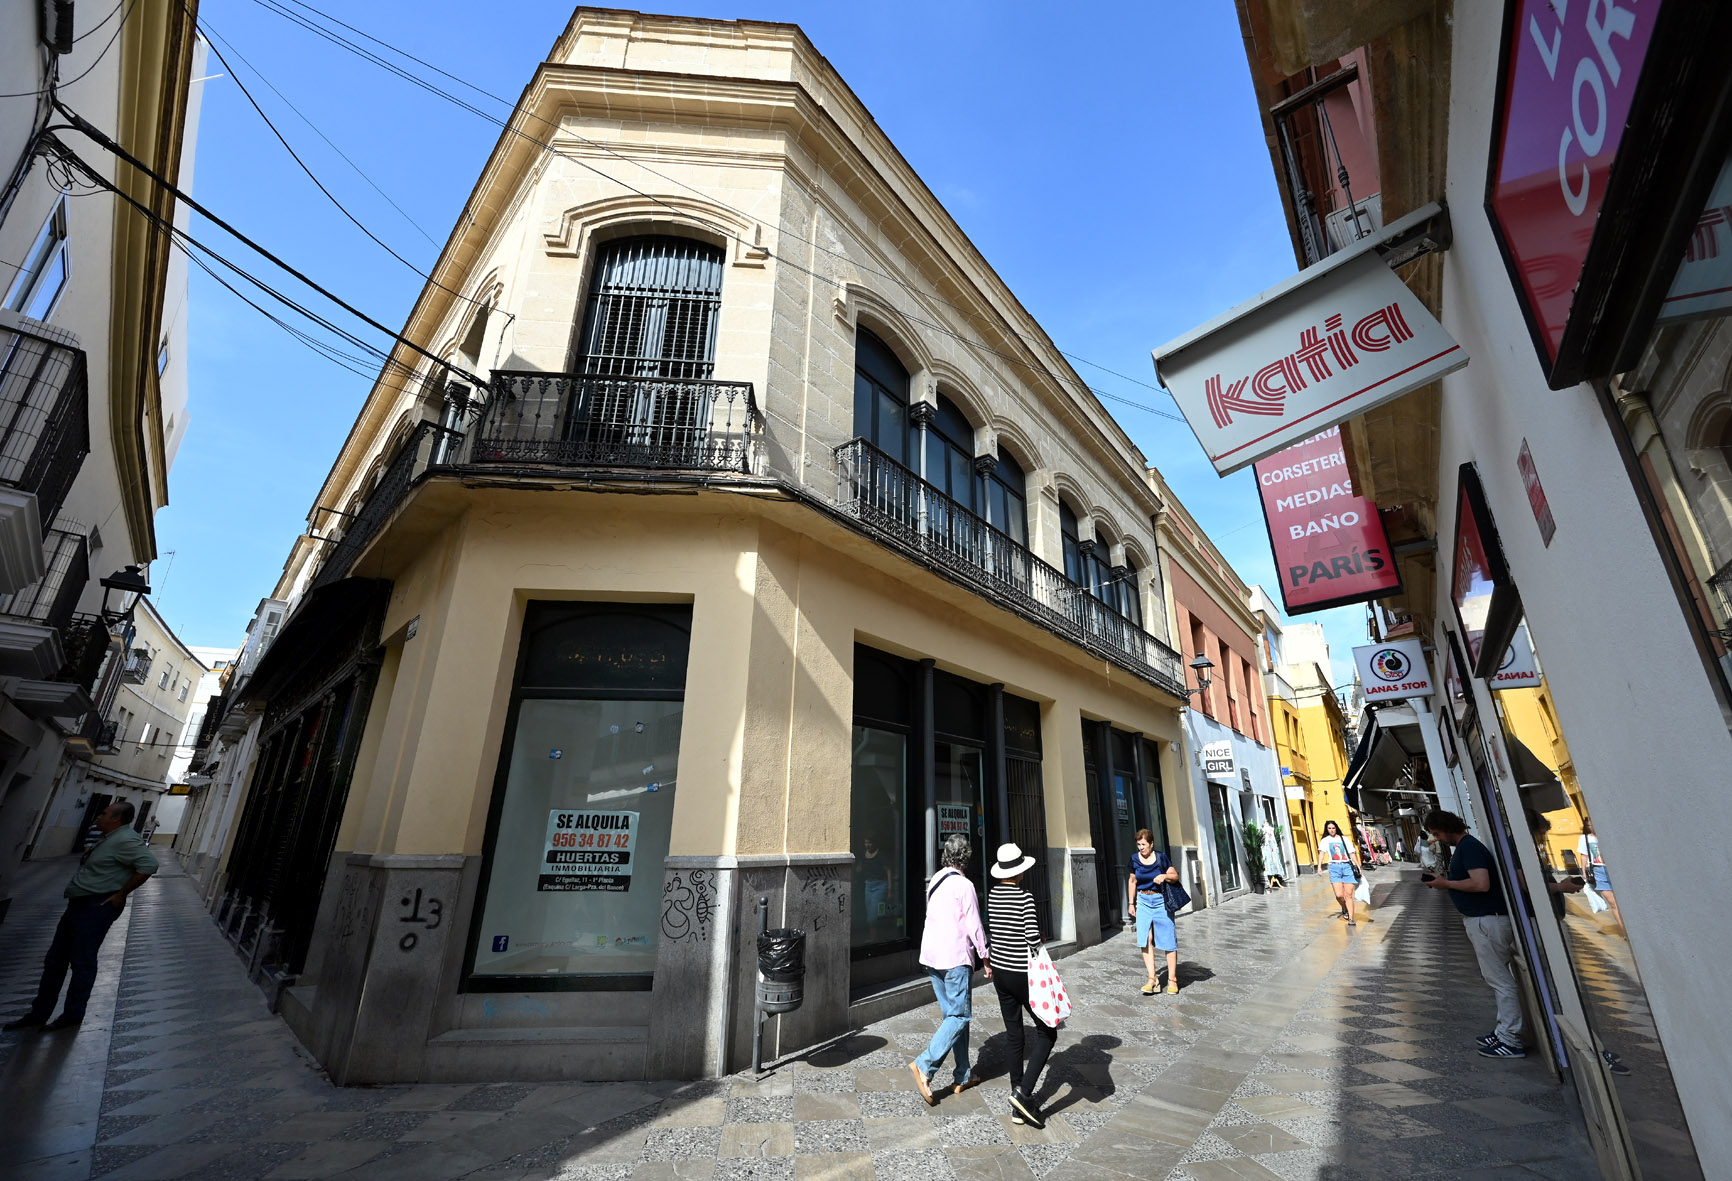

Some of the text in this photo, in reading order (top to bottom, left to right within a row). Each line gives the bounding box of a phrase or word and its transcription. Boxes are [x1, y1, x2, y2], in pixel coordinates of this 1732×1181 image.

[1559, 0, 1638, 217] COR
[1205, 302, 1414, 429] katia
[1276, 480, 1353, 512] MEDIAS
[1289, 512, 1359, 540] BAÑO
[1289, 546, 1385, 587] PARÍS
[1366, 684, 1399, 694] LANAS
[1205, 748, 1231, 757] NICE
[1207, 761, 1233, 771] GIRL
[941, 808, 968, 819] SE ALQUILA
[556, 814, 630, 830] SE ALQUILA
[552, 833, 630, 848] 956 34 87 42
[556, 852, 620, 863] HUERTAS
